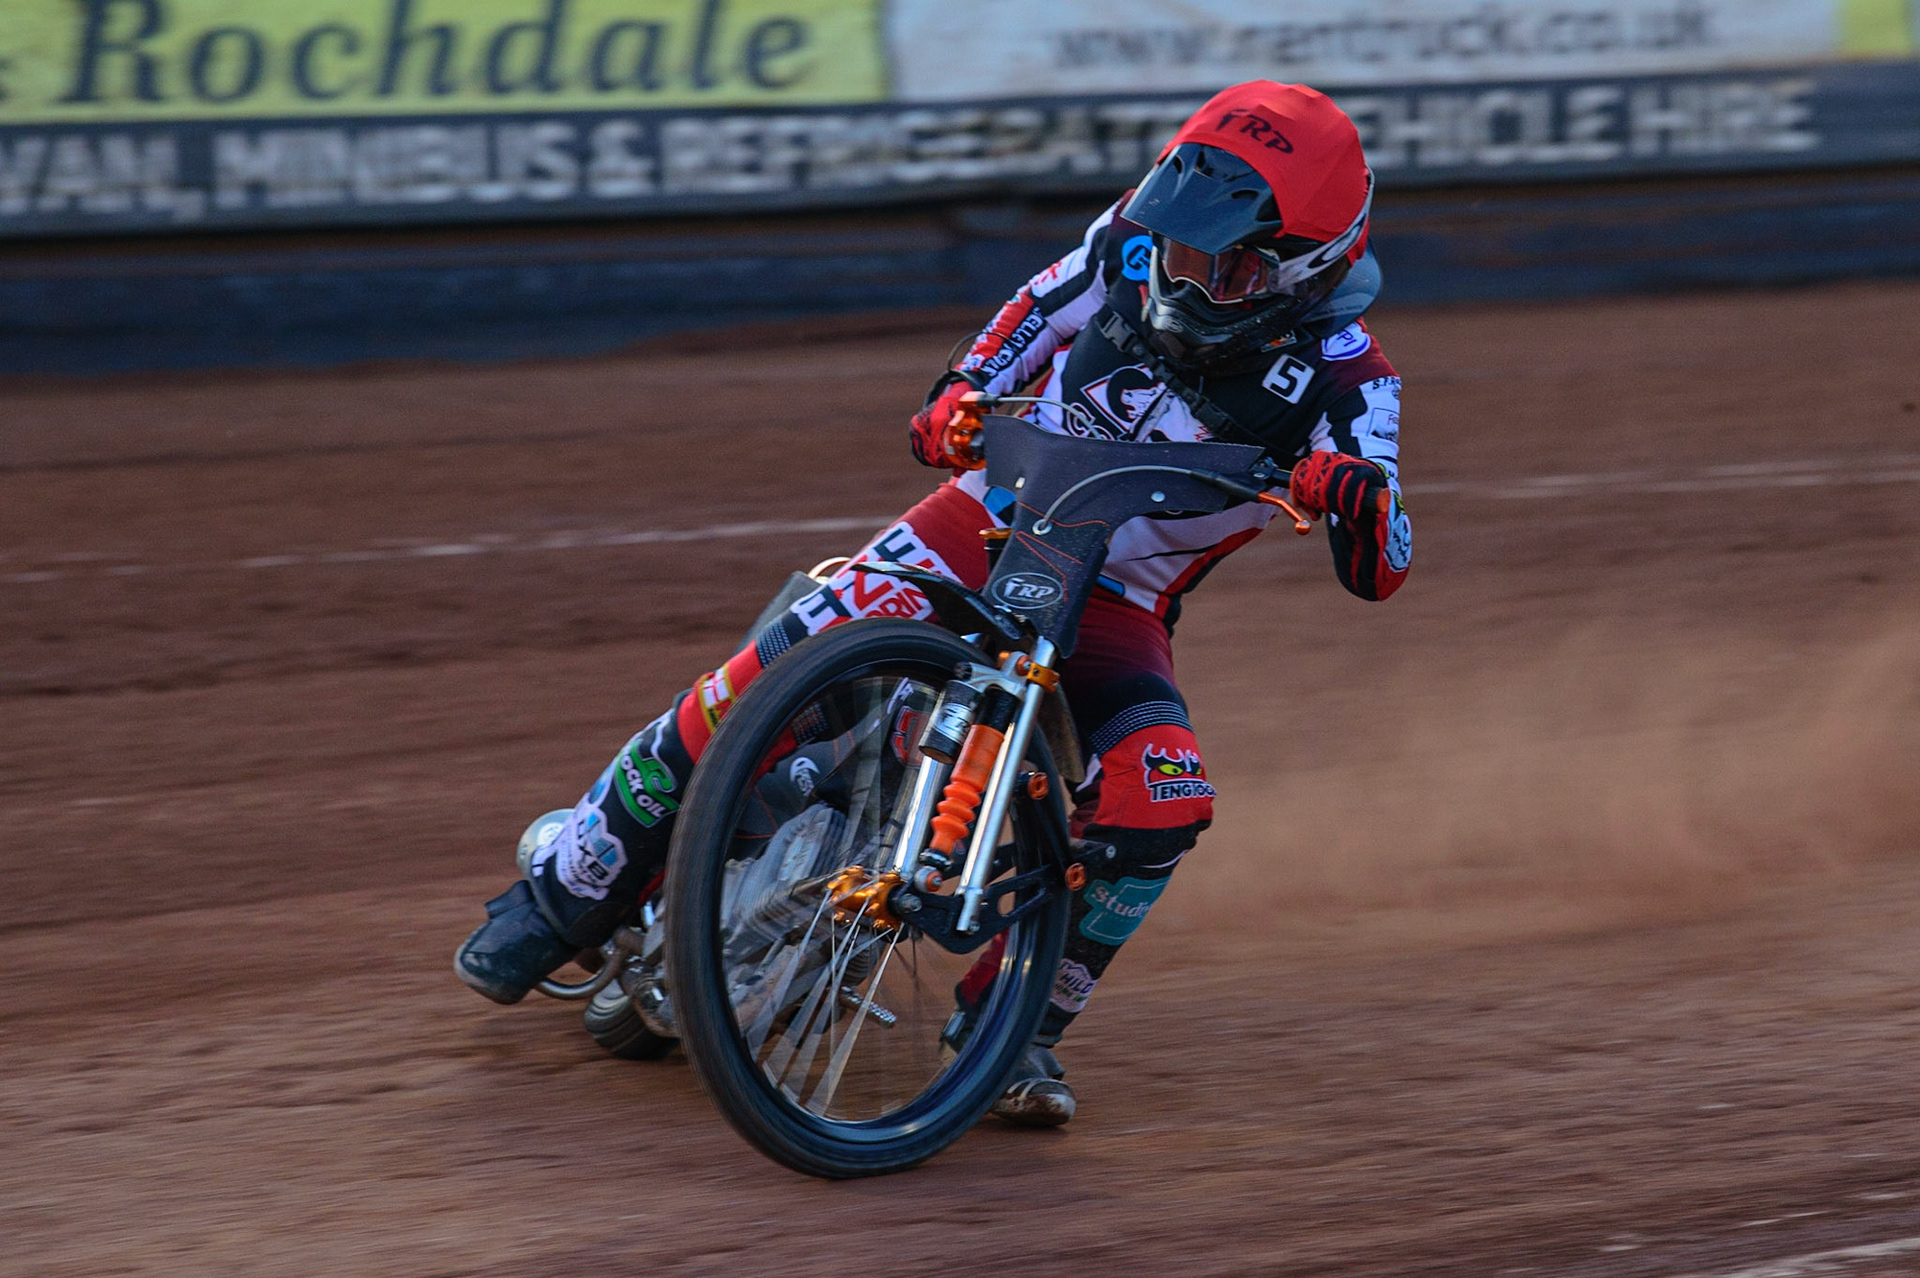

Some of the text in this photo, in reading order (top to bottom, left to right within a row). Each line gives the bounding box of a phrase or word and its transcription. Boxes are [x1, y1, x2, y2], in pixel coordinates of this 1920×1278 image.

[60, 0, 812, 106] Rochdale
[1268, 357, 1308, 398] 5
[1003, 577, 1055, 603] FRP
